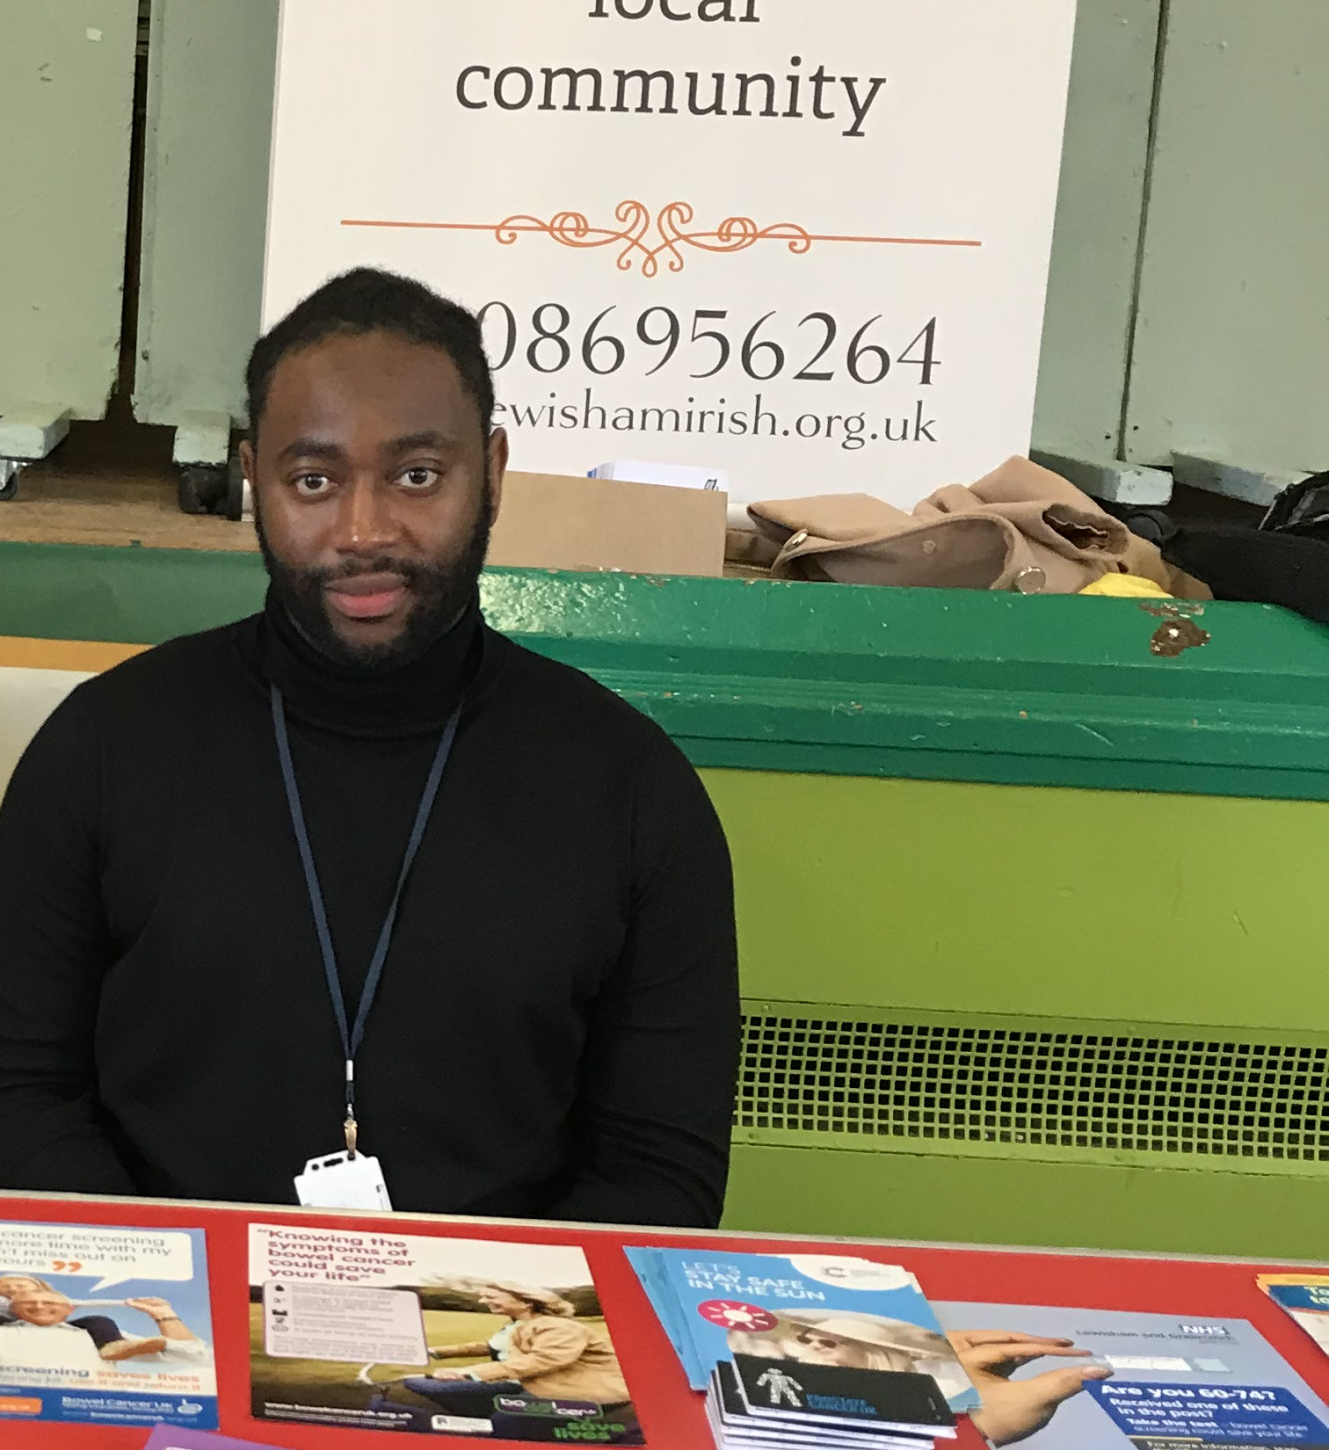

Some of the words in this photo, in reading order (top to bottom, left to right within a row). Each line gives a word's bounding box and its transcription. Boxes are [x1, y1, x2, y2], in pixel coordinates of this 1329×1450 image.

[456, 55, 887, 138] community
[476, 300, 943, 386] 086956264
[1, 1231, 64, 1241] cancer
[72, 1233, 166, 1247] screening
[370, 1238, 407, 1248] the
[23, 1248, 68, 1259] miss
[74, 1251, 105, 1262] out
[111, 1255, 137, 1263] on
[48, 1241, 90, 1251] time
[96, 1244, 137, 1254] with
[142, 1248, 172, 1257] my
[268, 1240, 380, 1256] symptoms
[387, 1249, 409, 1257] of
[268, 1248, 334, 1262] bowel
[341, 1256, 415, 1267] cancer
[268, 1259, 327, 1270] could
[335, 1265, 386, 1275] save
[268, 1268, 319, 1279] your
[685, 1269, 740, 1284] STAY
[747, 1276, 805, 1290] SAFE
[688, 1279, 714, 1291] IN
[722, 1282, 768, 1296] THE
[773, 1288, 826, 1301] SUN
[1182, 1324, 1226, 1336] NHS
[96, 1370, 152, 1380] saves
[157, 1372, 200, 1383] lives
[1101, 1384, 1143, 1396] Are
[1146, 1387, 1195, 1399] you
[1199, 1389, 1276, 1401] 60-74?
[1109, 1398, 1184, 1410] Received
[1187, 1402, 1218, 1410] one
[1221, 1402, 1239, 1411] of
[1242, 1404, 1289, 1413] these
[1139, 1408, 1169, 1417] the
[567, 1422, 625, 1433] save
[1126, 1418, 1159, 1427] Take
[1162, 1419, 1186, 1428] the
[1189, 1420, 1218, 1429] test
[554, 1427, 612, 1440] lives
